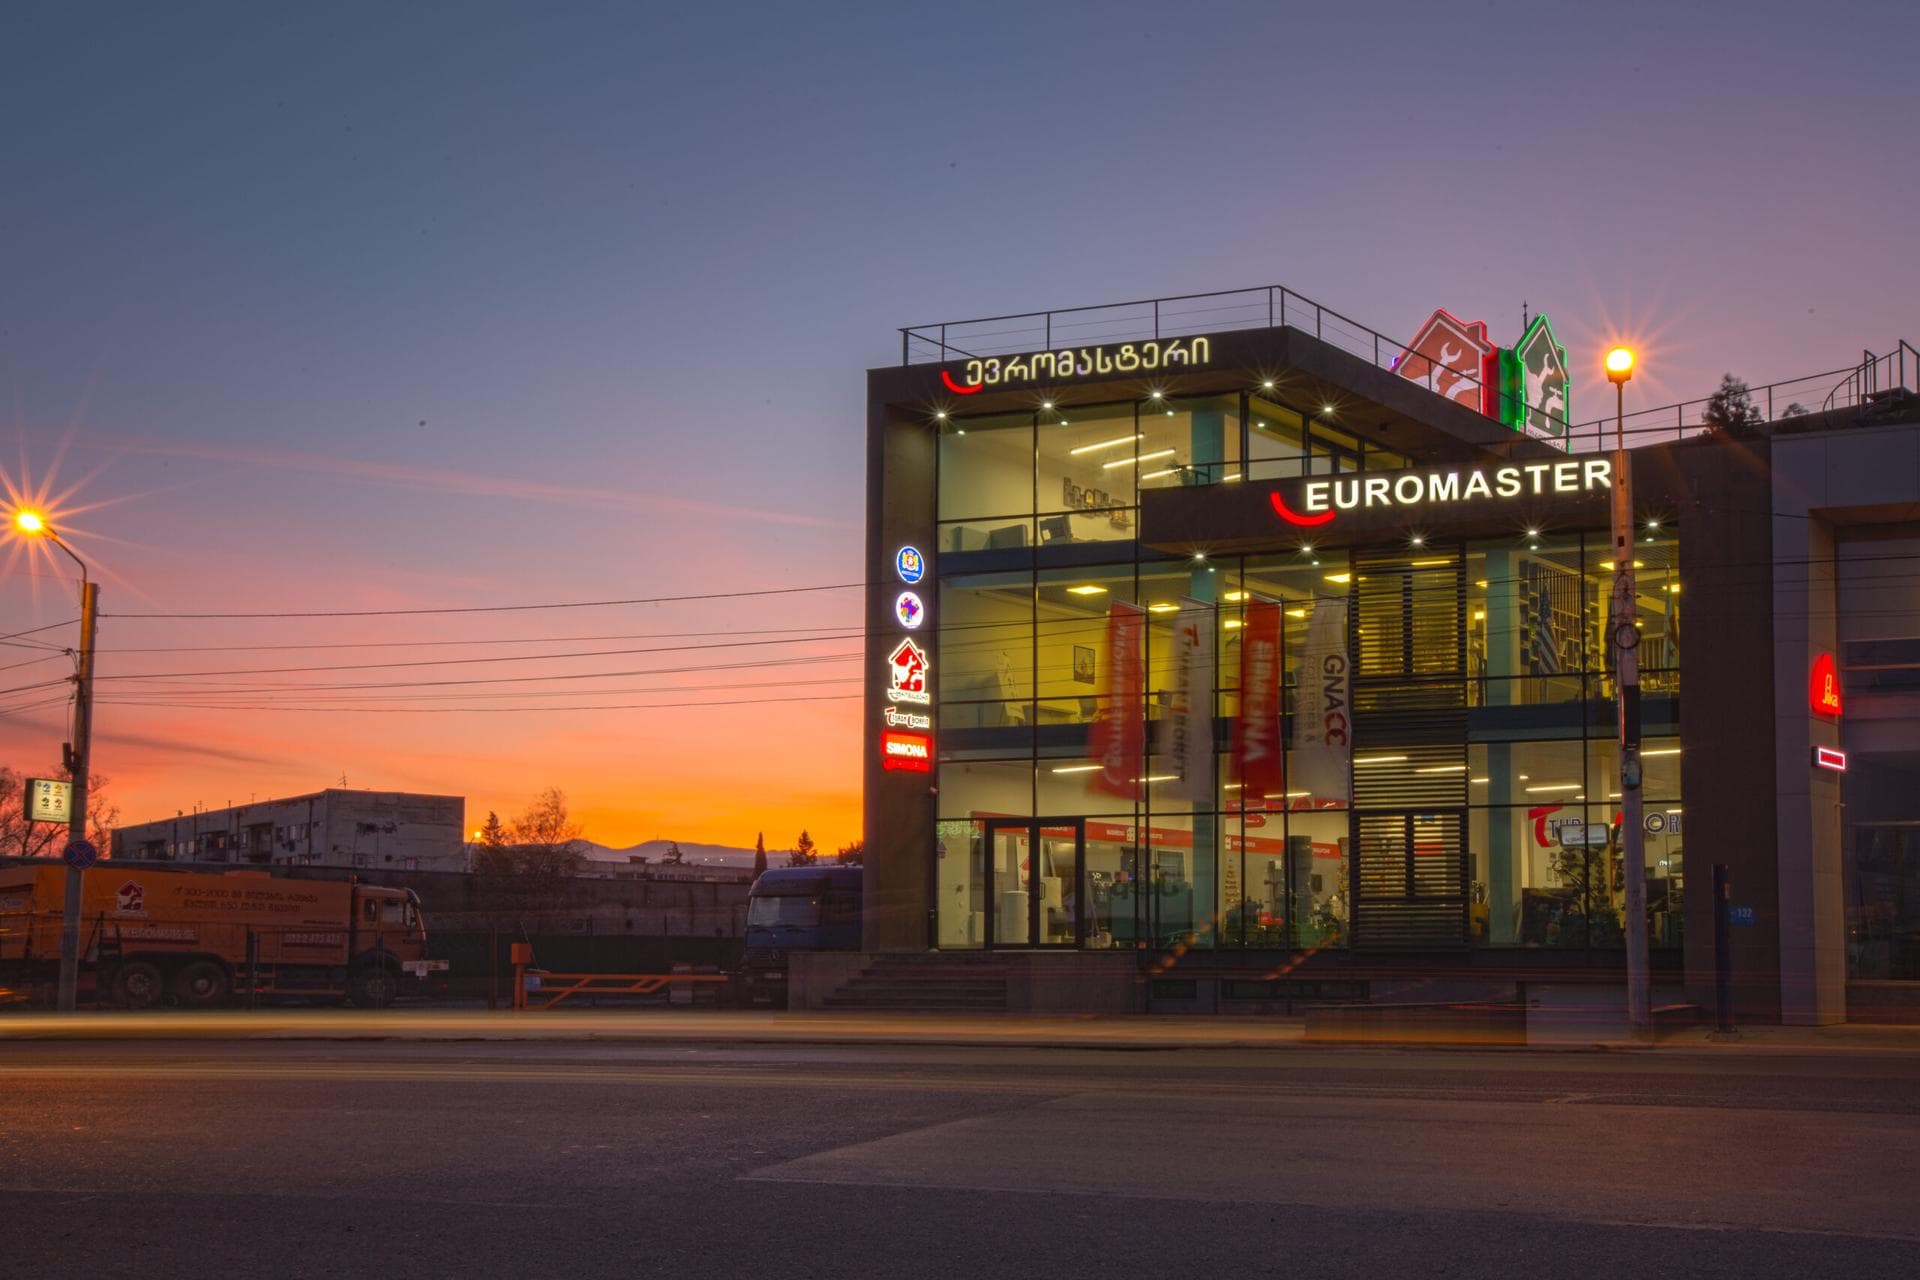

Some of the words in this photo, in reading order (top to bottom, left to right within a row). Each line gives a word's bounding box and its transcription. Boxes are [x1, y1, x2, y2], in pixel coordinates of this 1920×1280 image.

[966, 337, 1209, 385] ევრომასტერი
[1306, 459, 1612, 511] EUROMASTER
[886, 741, 929, 759] SIMONA
